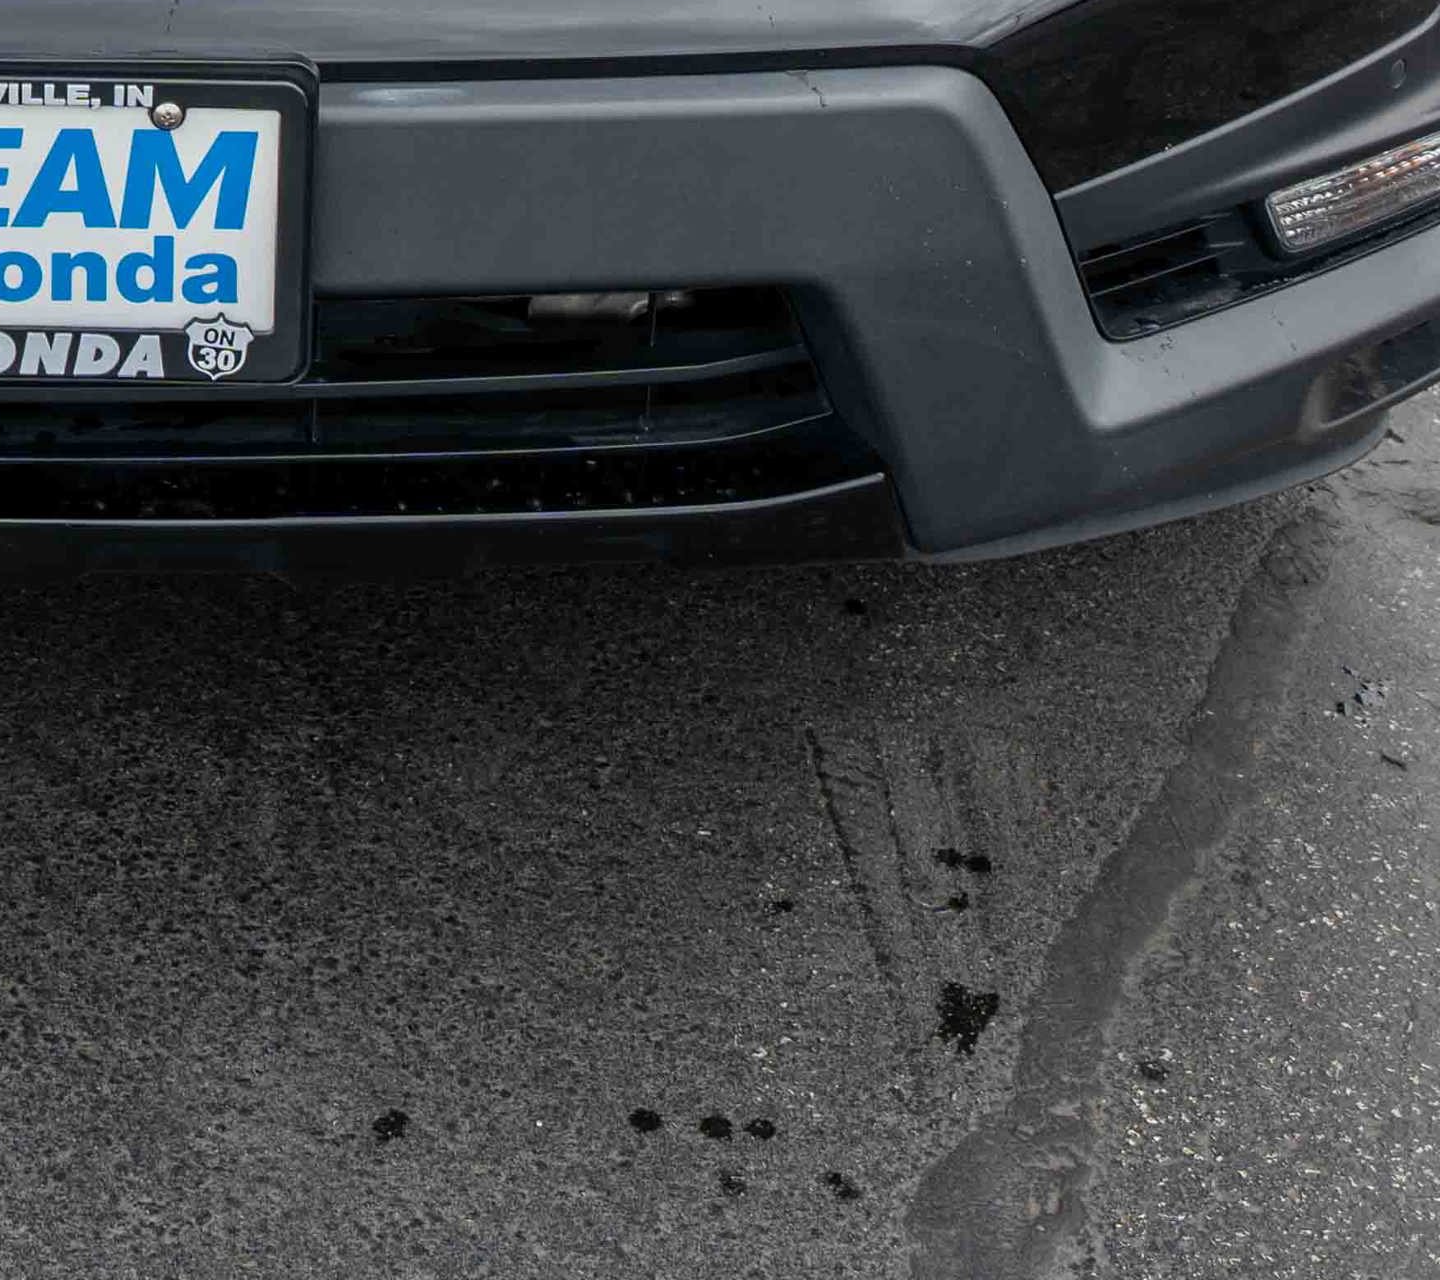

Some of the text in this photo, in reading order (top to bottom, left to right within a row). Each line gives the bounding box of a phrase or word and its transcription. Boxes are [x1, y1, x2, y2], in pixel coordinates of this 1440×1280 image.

[114, 84, 154, 108] IN
[203, 327, 236, 348] ON
[197, 346, 236, 372] 30
